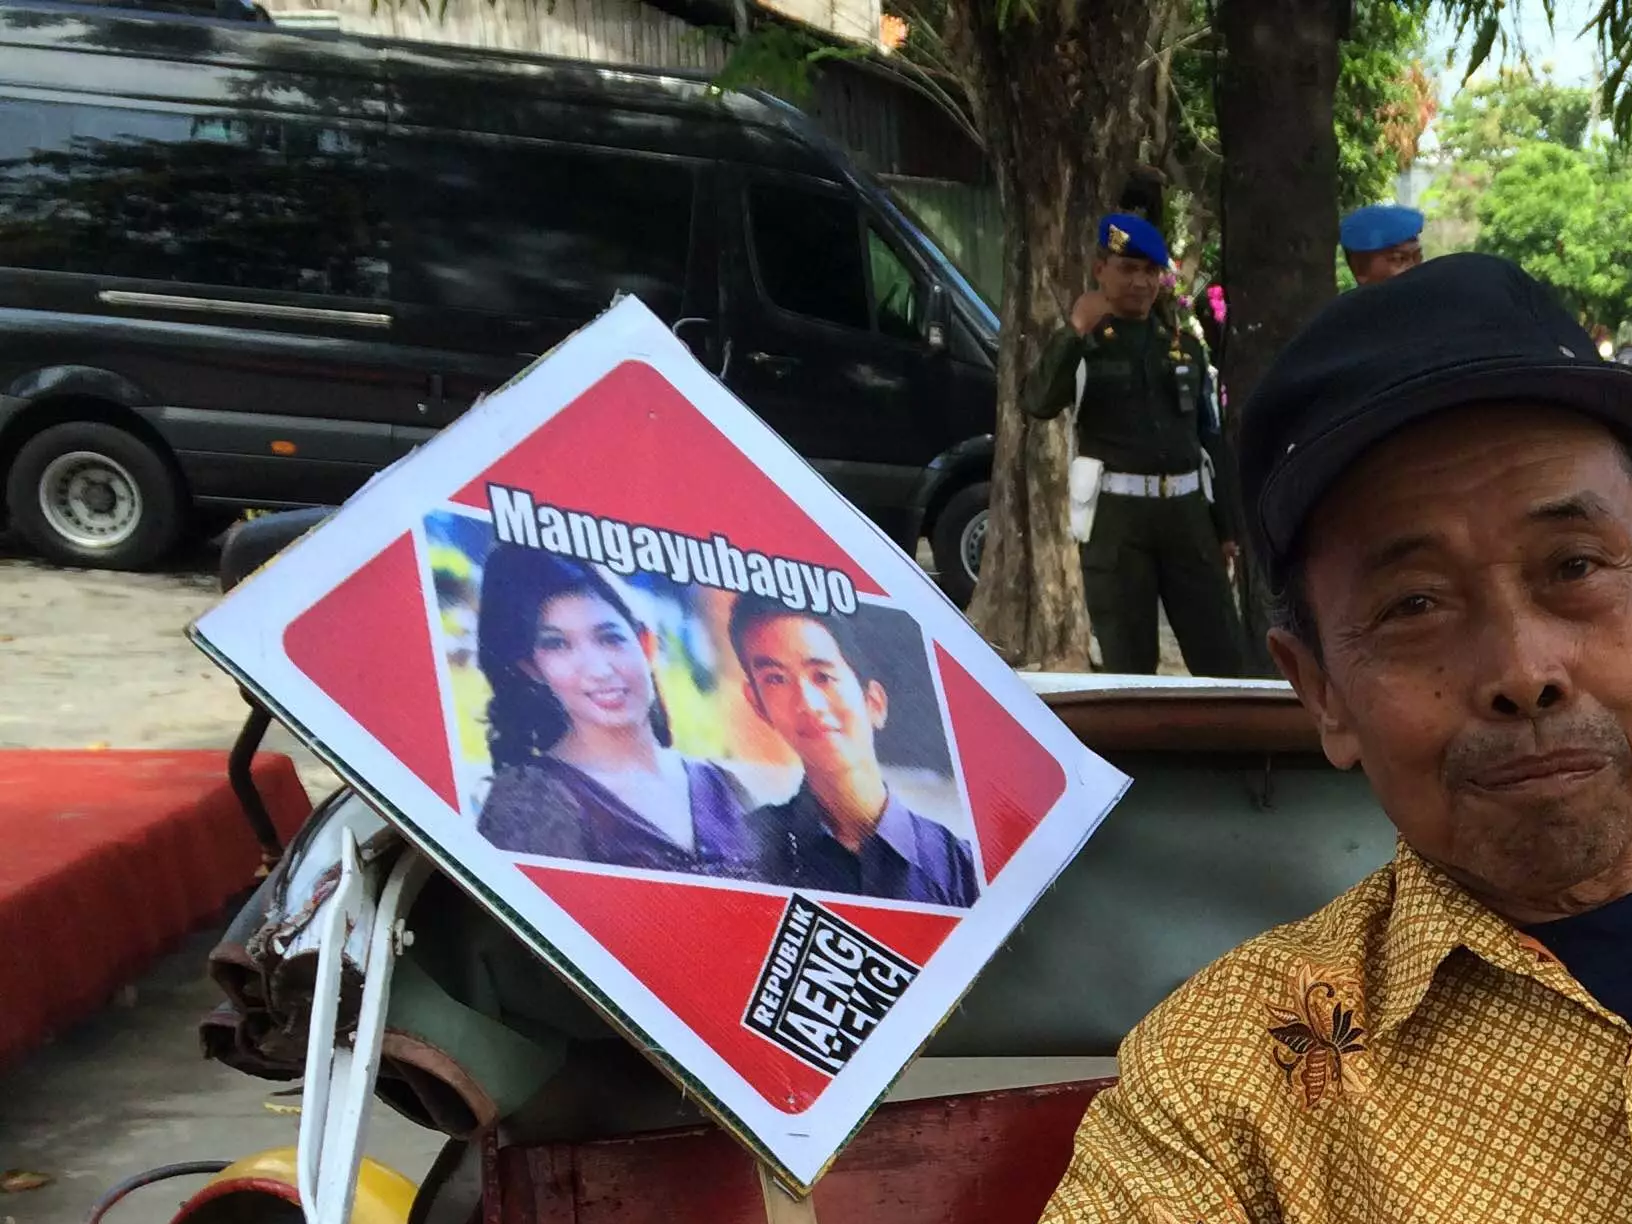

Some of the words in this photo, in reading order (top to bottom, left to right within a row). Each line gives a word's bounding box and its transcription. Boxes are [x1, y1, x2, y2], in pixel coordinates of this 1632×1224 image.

[488, 483, 857, 614] Mangayubagyo
[752, 904, 815, 1028] REPUBLIK
[785, 929, 865, 1058] AENG
